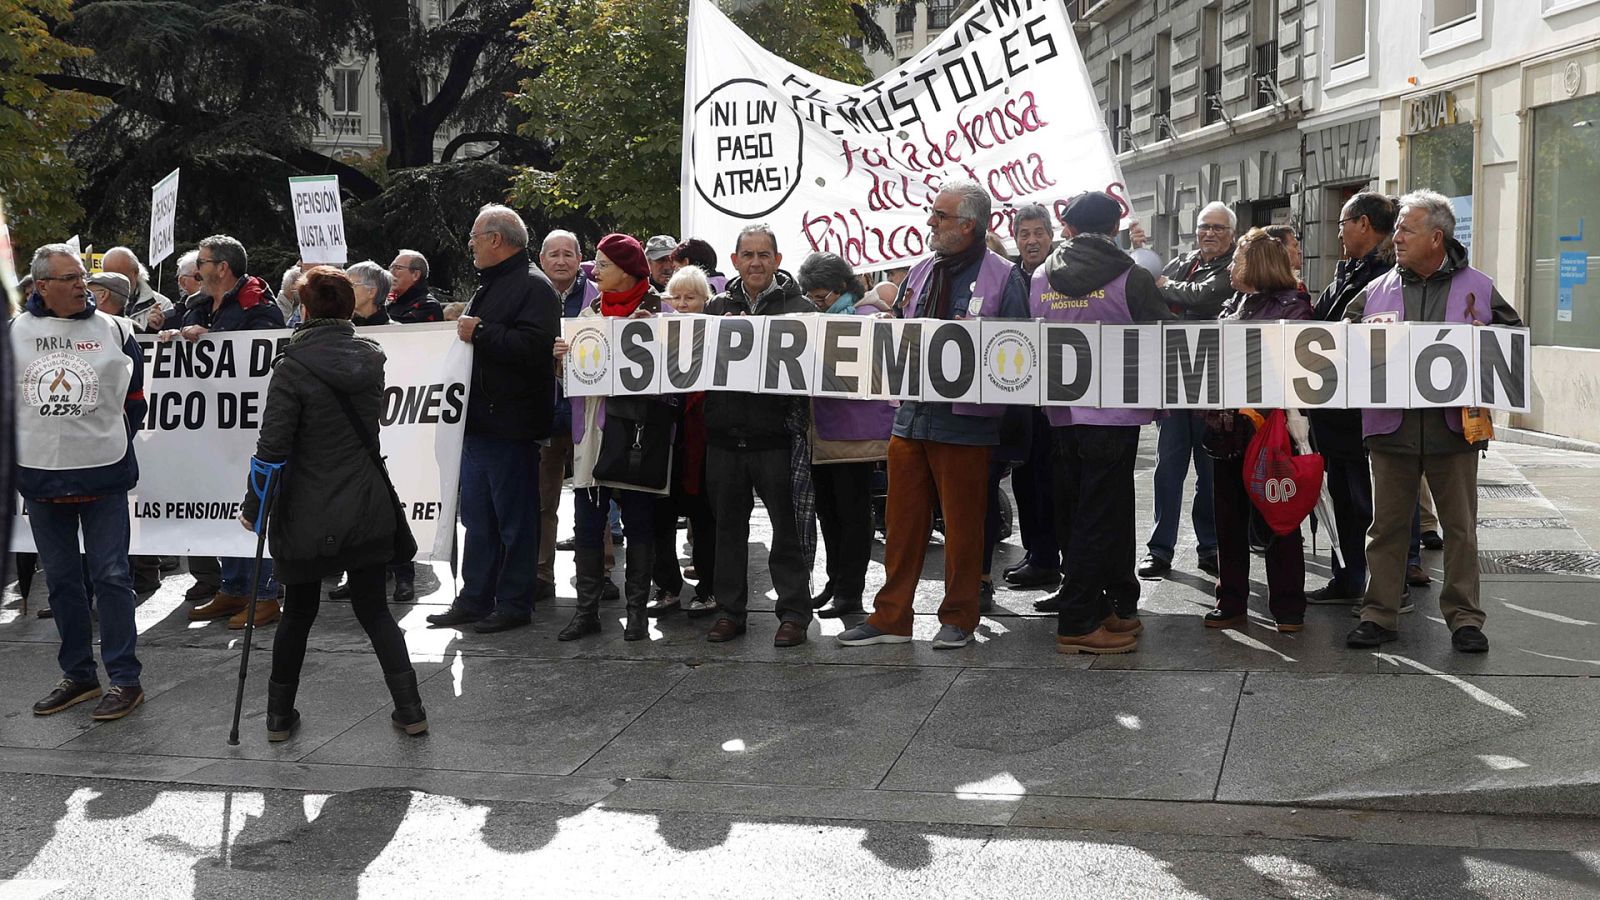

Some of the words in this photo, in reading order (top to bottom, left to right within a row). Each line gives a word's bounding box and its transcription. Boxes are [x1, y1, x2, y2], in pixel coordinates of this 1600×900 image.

[710, 101, 736, 127] ¡NI
[747, 100, 777, 125] UN
[717, 132, 773, 162] PASO
[713, 163, 789, 198] ATRÁS!
[295, 186, 338, 221] ¡PENSIÓN
[301, 225, 328, 250] JUSTA,
[327, 224, 343, 246] YA!
[1051, 300, 1089, 310] MÓSTOLES
[36, 337, 73, 351] PARLA
[77, 342, 100, 351] NO+
[619, 319, 976, 400] SUPREMO
[1046, 327, 1525, 409] DIMISIÓN
[40, 403, 81, 417] 0,25%
[217, 391, 259, 429] DE
[134, 501, 161, 518] LAS
[166, 501, 245, 520] PENSIONE
